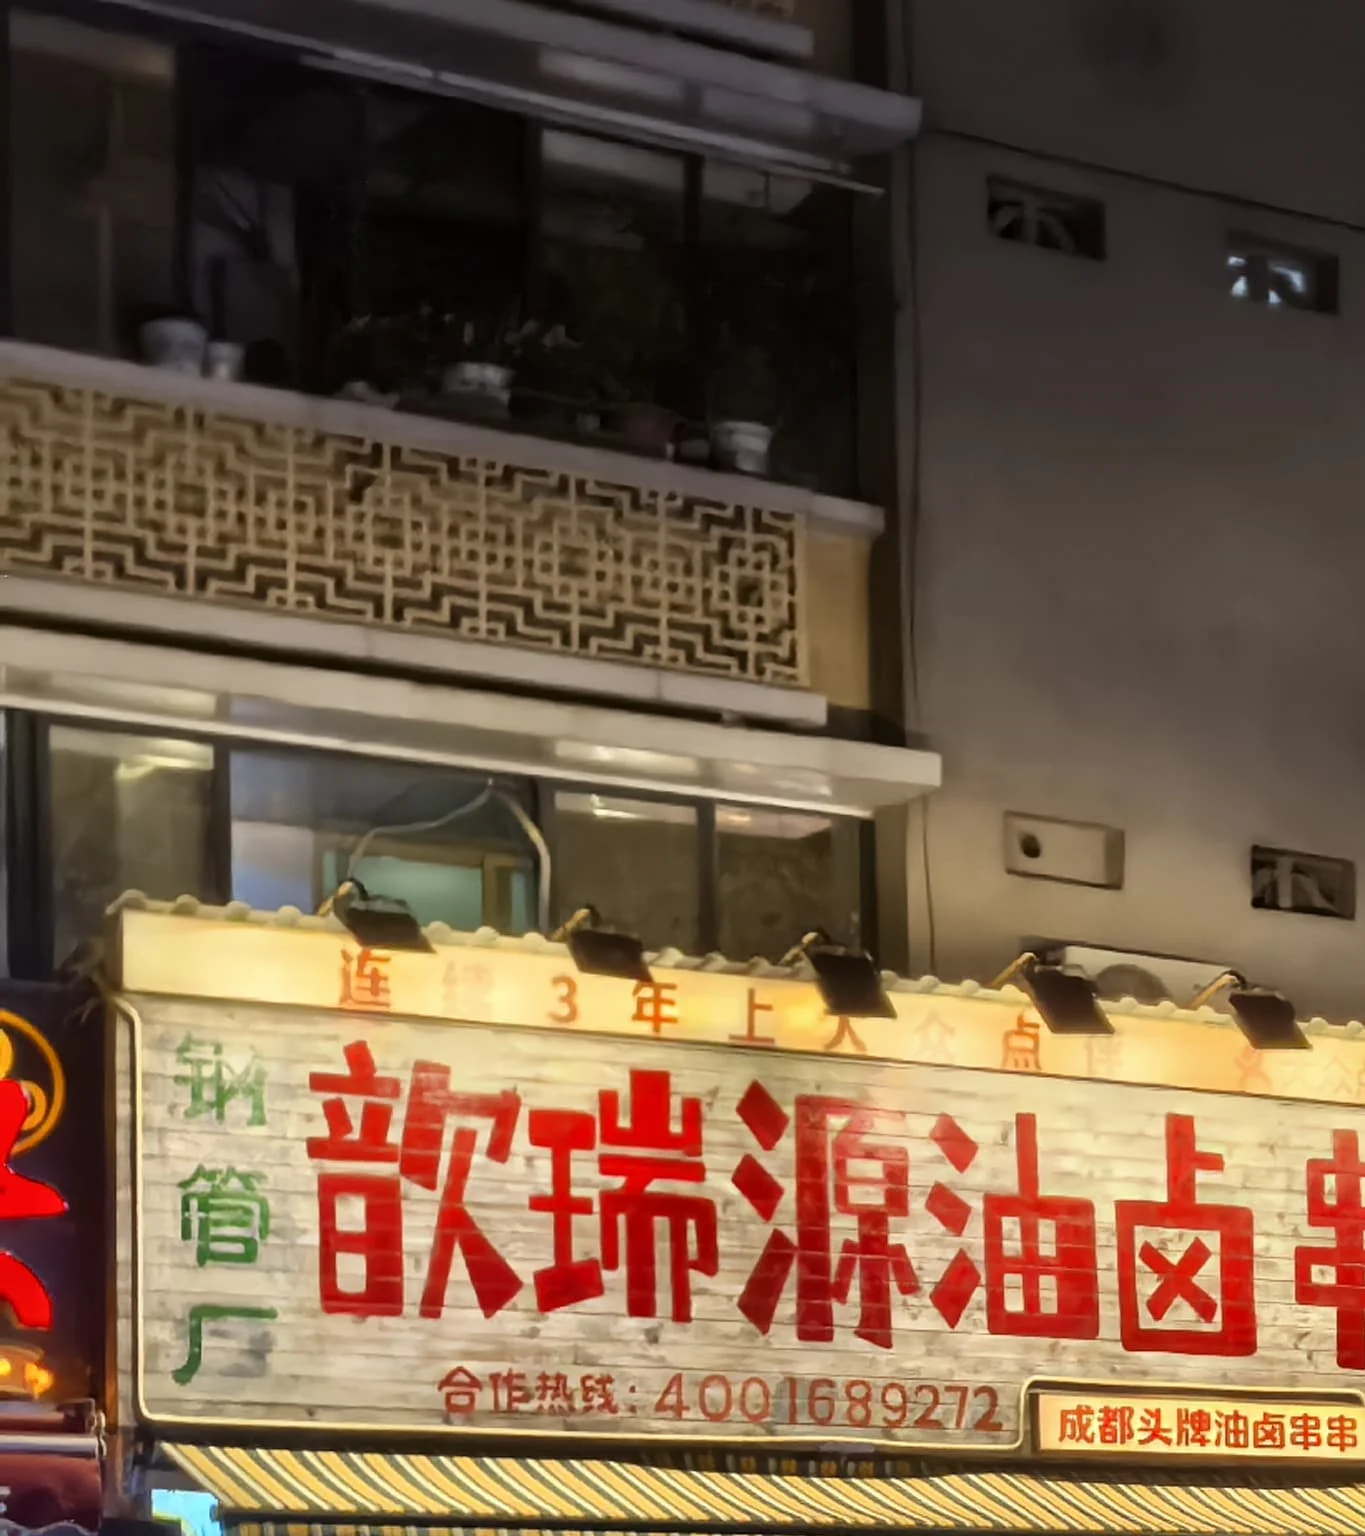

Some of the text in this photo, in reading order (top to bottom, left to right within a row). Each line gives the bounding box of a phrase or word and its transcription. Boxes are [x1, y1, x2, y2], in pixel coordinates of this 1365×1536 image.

[171, 1031, 279, 1386] 钢管厂
[654, 1372, 1005, 1432] 4001689272
[1058, 1405, 1358, 1454] 成都头牌油卤串串
